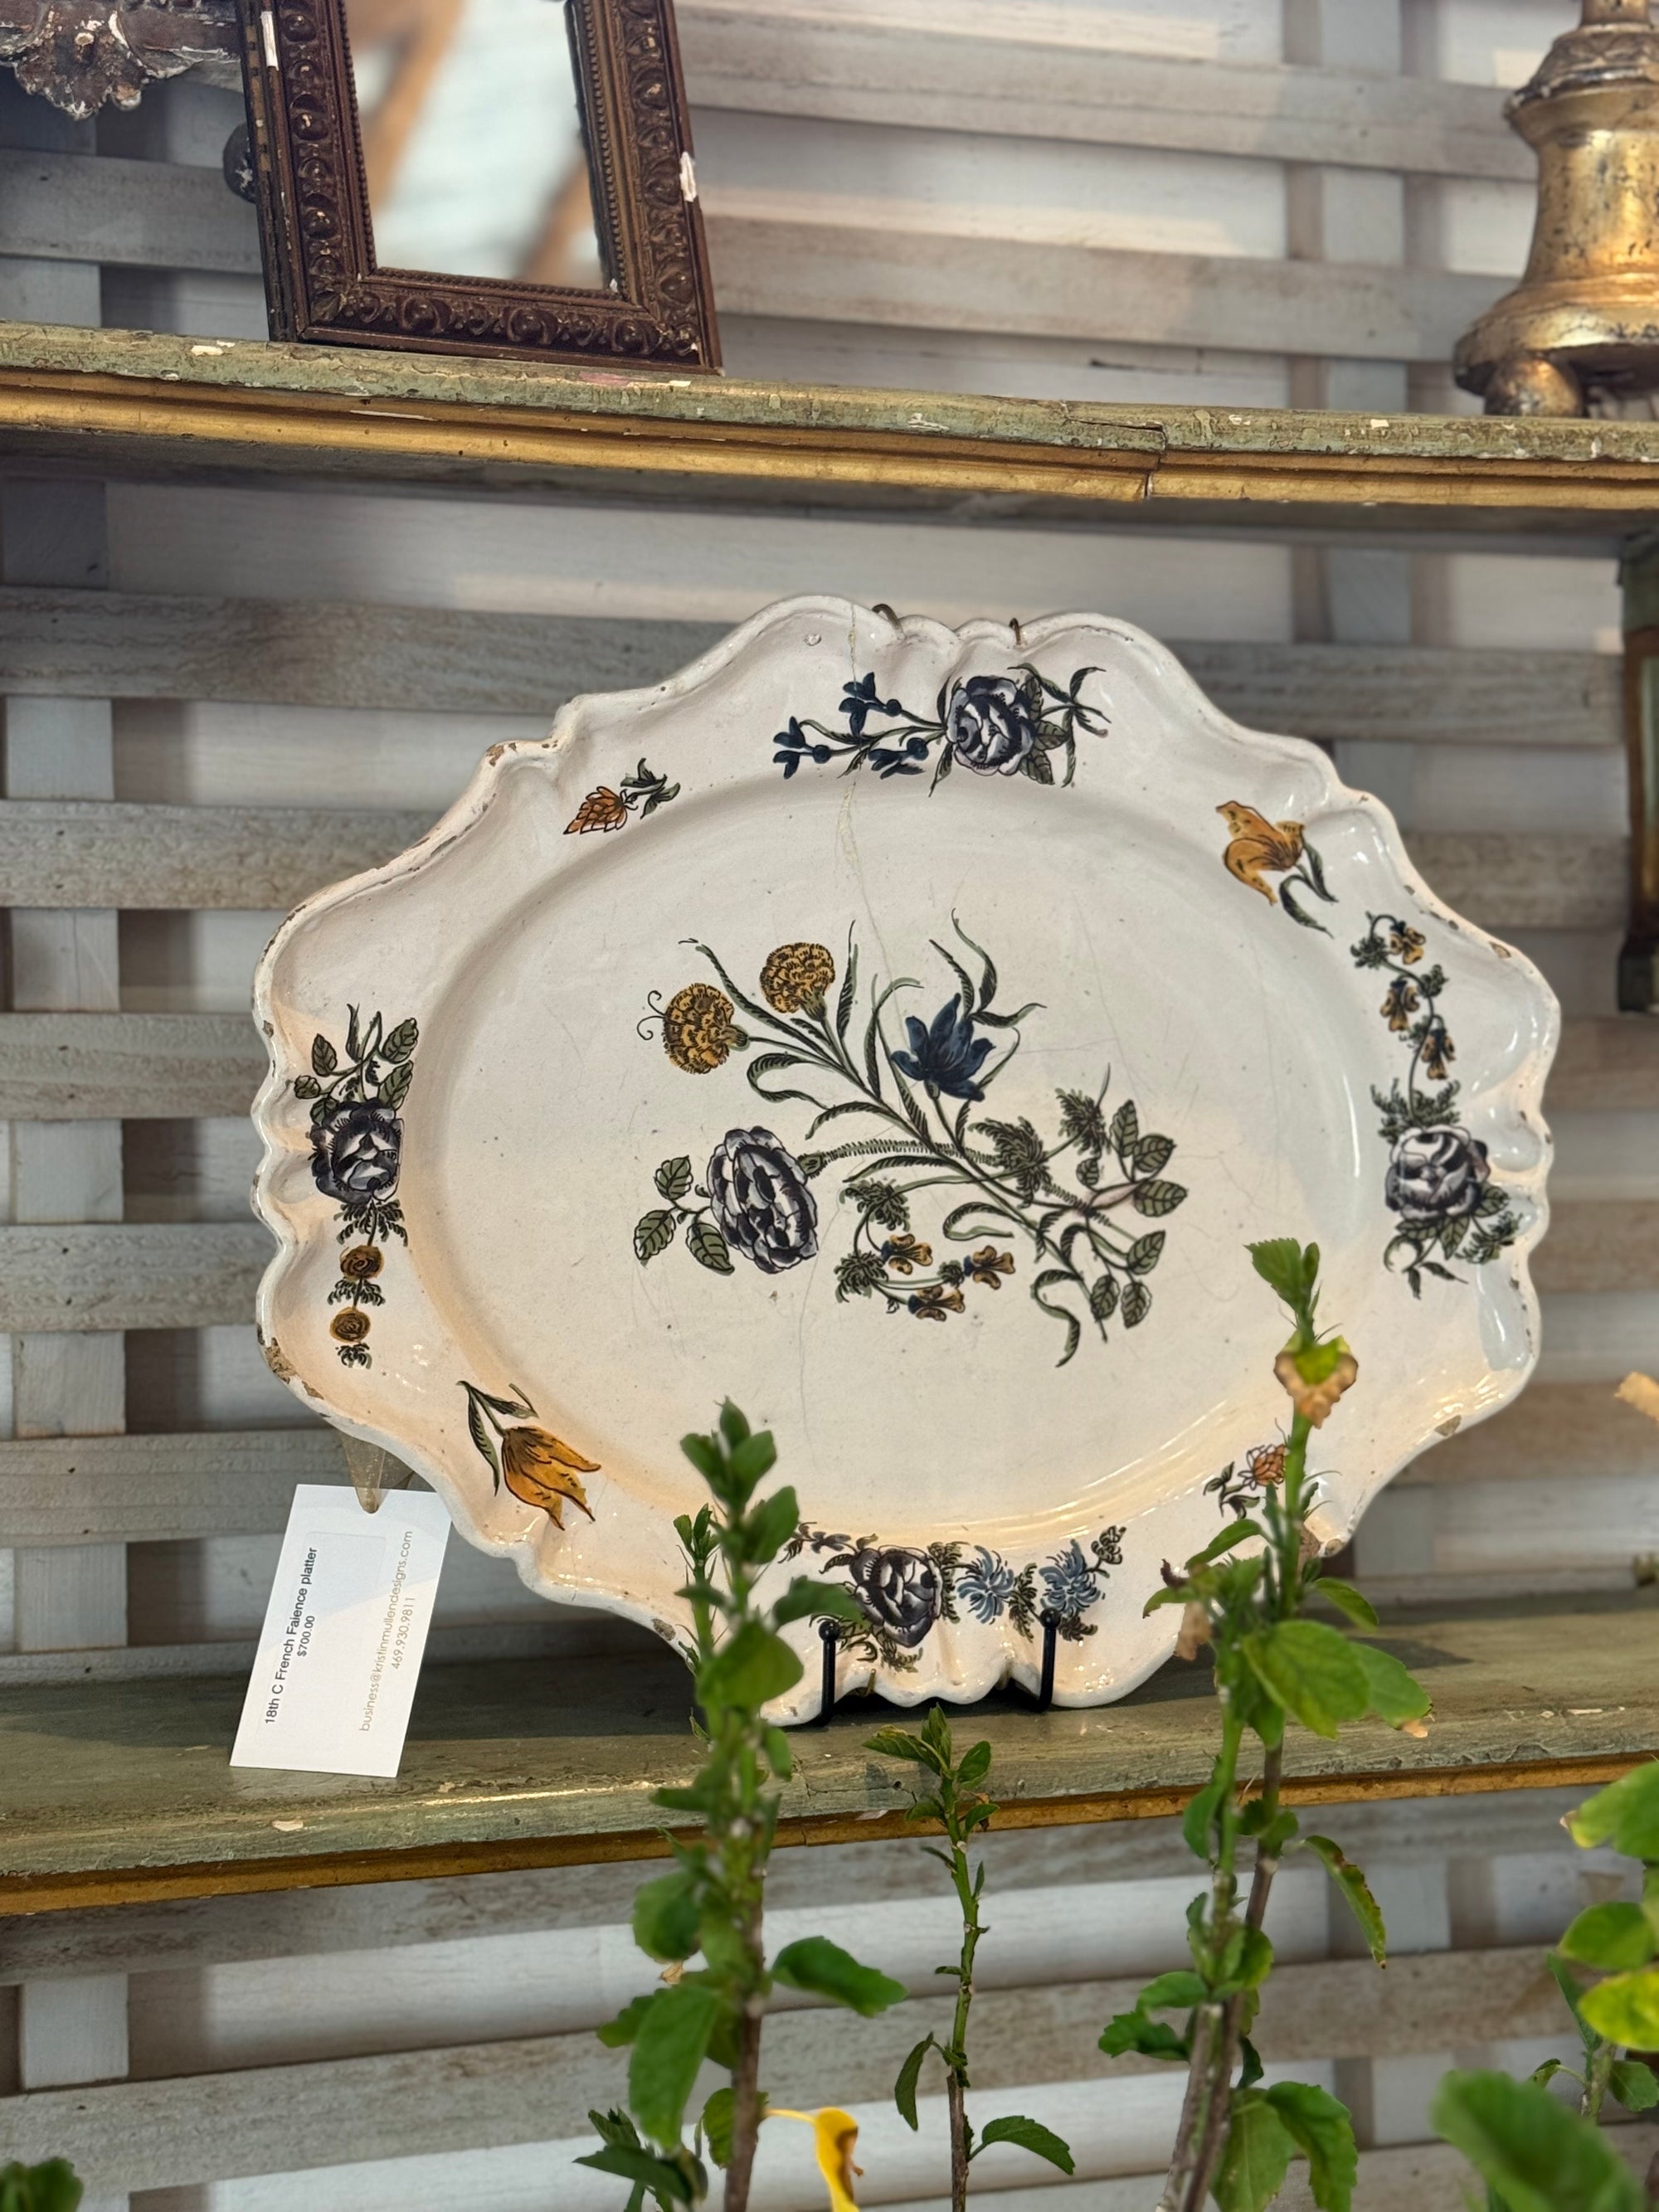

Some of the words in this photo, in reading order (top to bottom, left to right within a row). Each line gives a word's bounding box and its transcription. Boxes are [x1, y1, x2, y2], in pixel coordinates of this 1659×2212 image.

[300, 1548, 318, 1585] platter
[286, 1588, 308, 1635] Faience
[297, 1616, 315, 1657] $700.00
[392, 1597, 416, 1669] 469.930.9811
[275, 1639, 294, 1680] French
[265, 1697, 280, 1723] 18th
[272, 1685, 284, 1694] C
